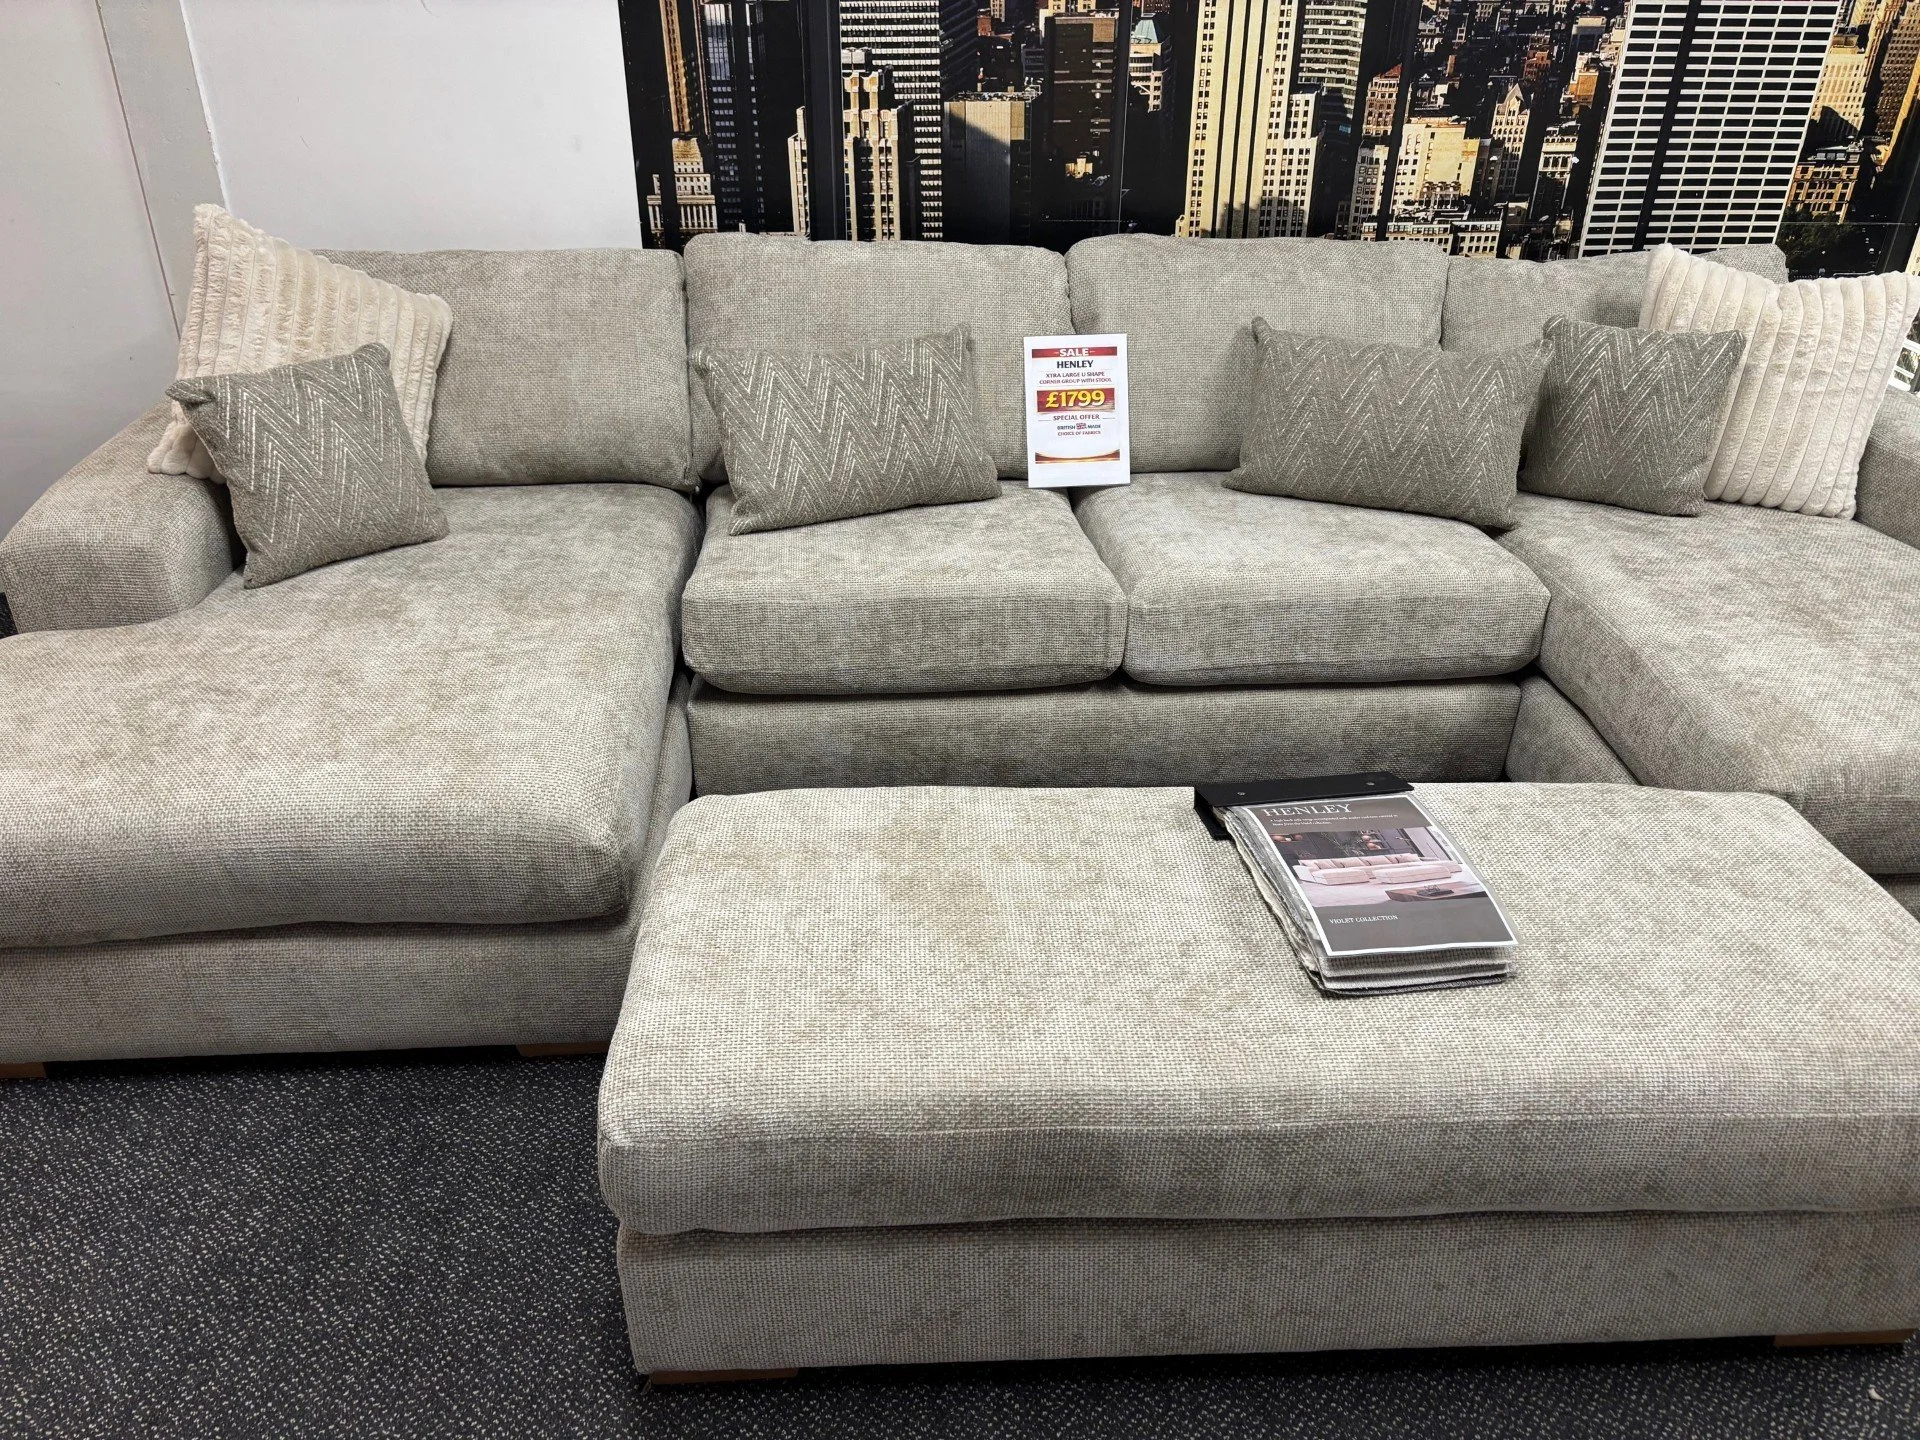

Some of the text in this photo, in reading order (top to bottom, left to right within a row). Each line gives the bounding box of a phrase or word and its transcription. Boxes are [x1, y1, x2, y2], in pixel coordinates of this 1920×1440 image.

[1060, 348, 1089, 357] SALE
[1056, 360, 1093, 369] HENLEY
[1045, 390, 1105, 408] £1799
[1263, 803, 1352, 817] HENLEY
[1355, 914, 1399, 923] COLLECTION
